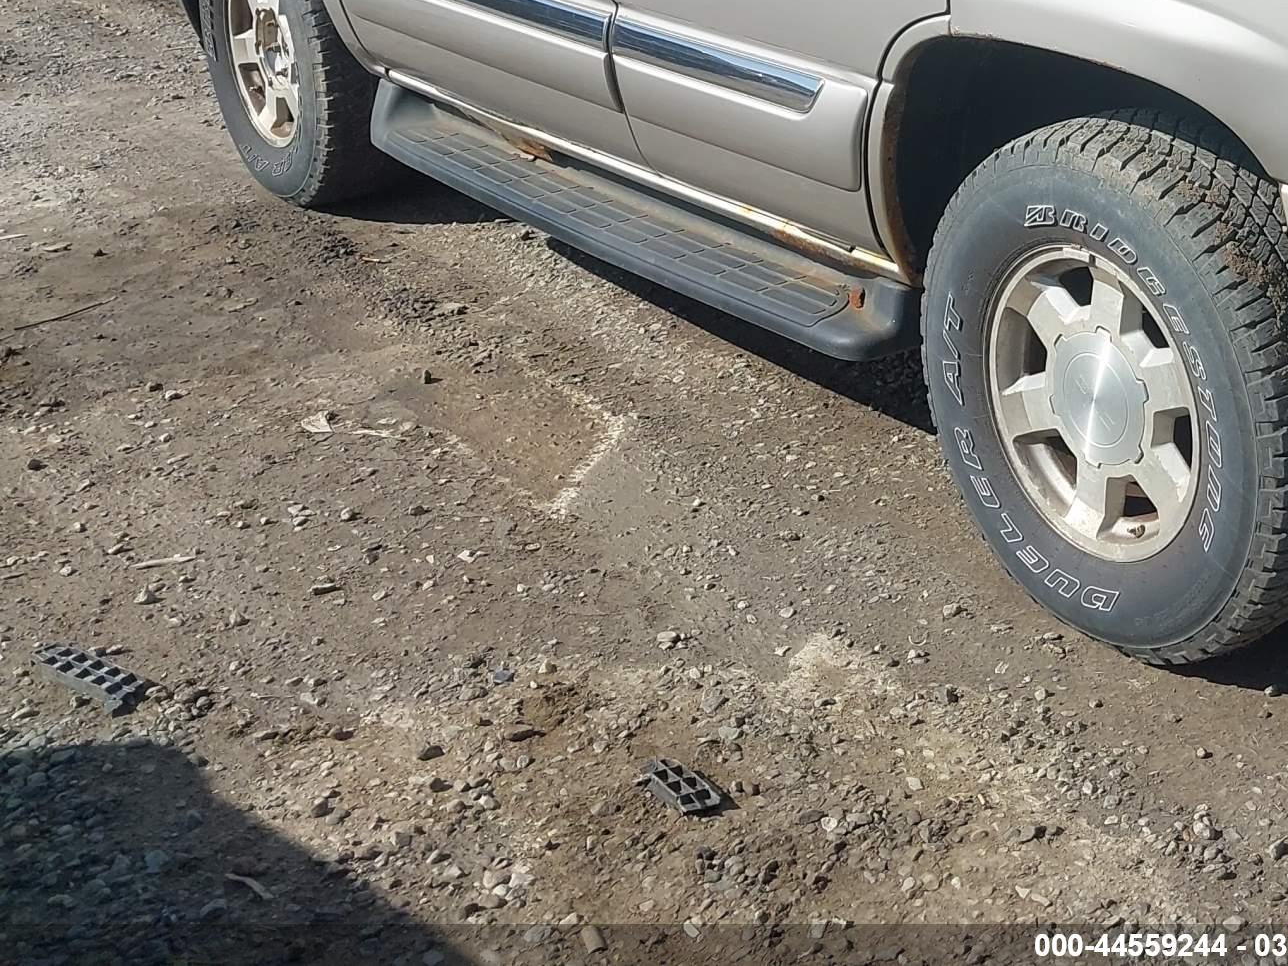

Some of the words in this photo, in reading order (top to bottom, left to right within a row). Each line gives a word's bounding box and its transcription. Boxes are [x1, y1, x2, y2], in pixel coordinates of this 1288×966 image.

[941, 290, 965, 407] A/T
[1023, 204, 1224, 554] BRIDGESTONE
[954, 425, 1120, 612] DUELER
